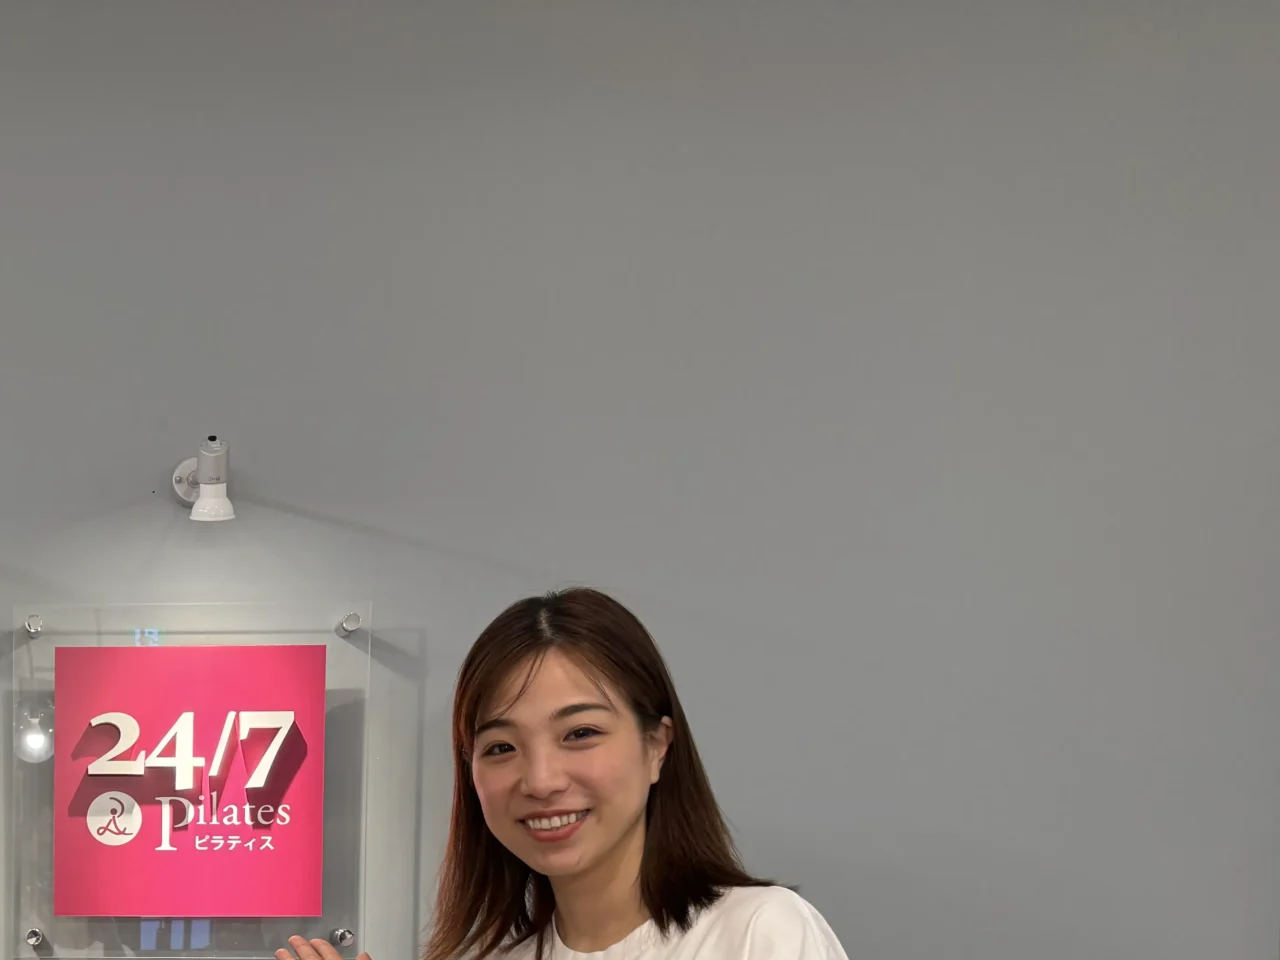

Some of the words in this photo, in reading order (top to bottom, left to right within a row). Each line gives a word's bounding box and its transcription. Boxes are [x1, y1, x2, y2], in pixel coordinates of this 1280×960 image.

[86, 710, 295, 791] 24/7
[154, 791, 292, 851] Pilates
[194, 835, 275, 851] ピラティス
